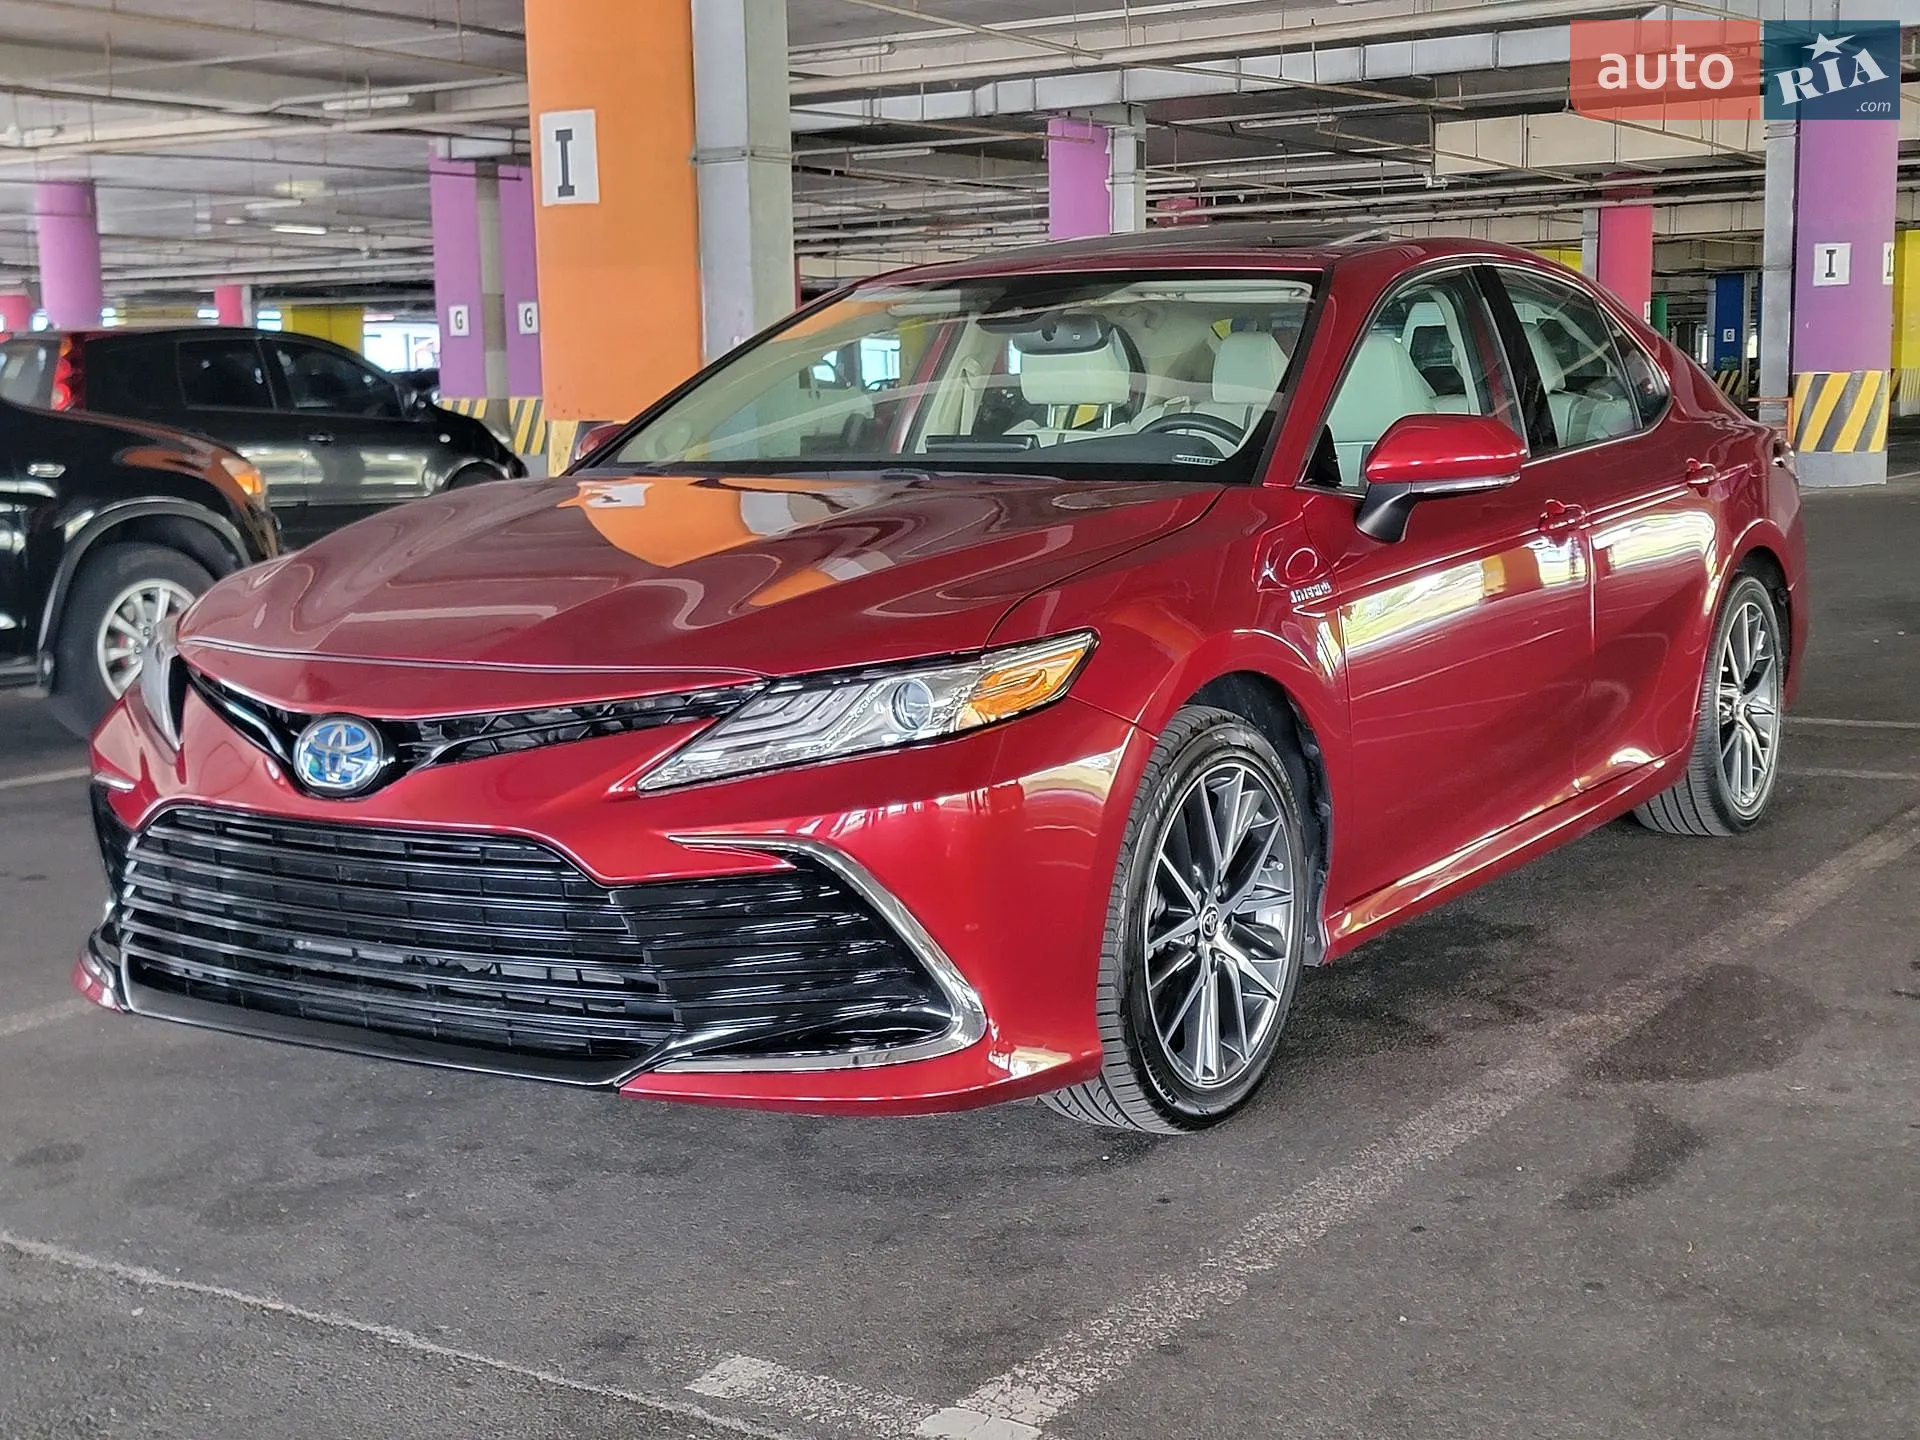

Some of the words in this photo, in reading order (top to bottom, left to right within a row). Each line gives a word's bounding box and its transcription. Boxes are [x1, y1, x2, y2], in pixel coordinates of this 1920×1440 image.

[556, 129, 575, 197] I
[1825, 249, 1837, 278] I
[455, 310, 463, 330] G
[524, 308, 533, 328] G
